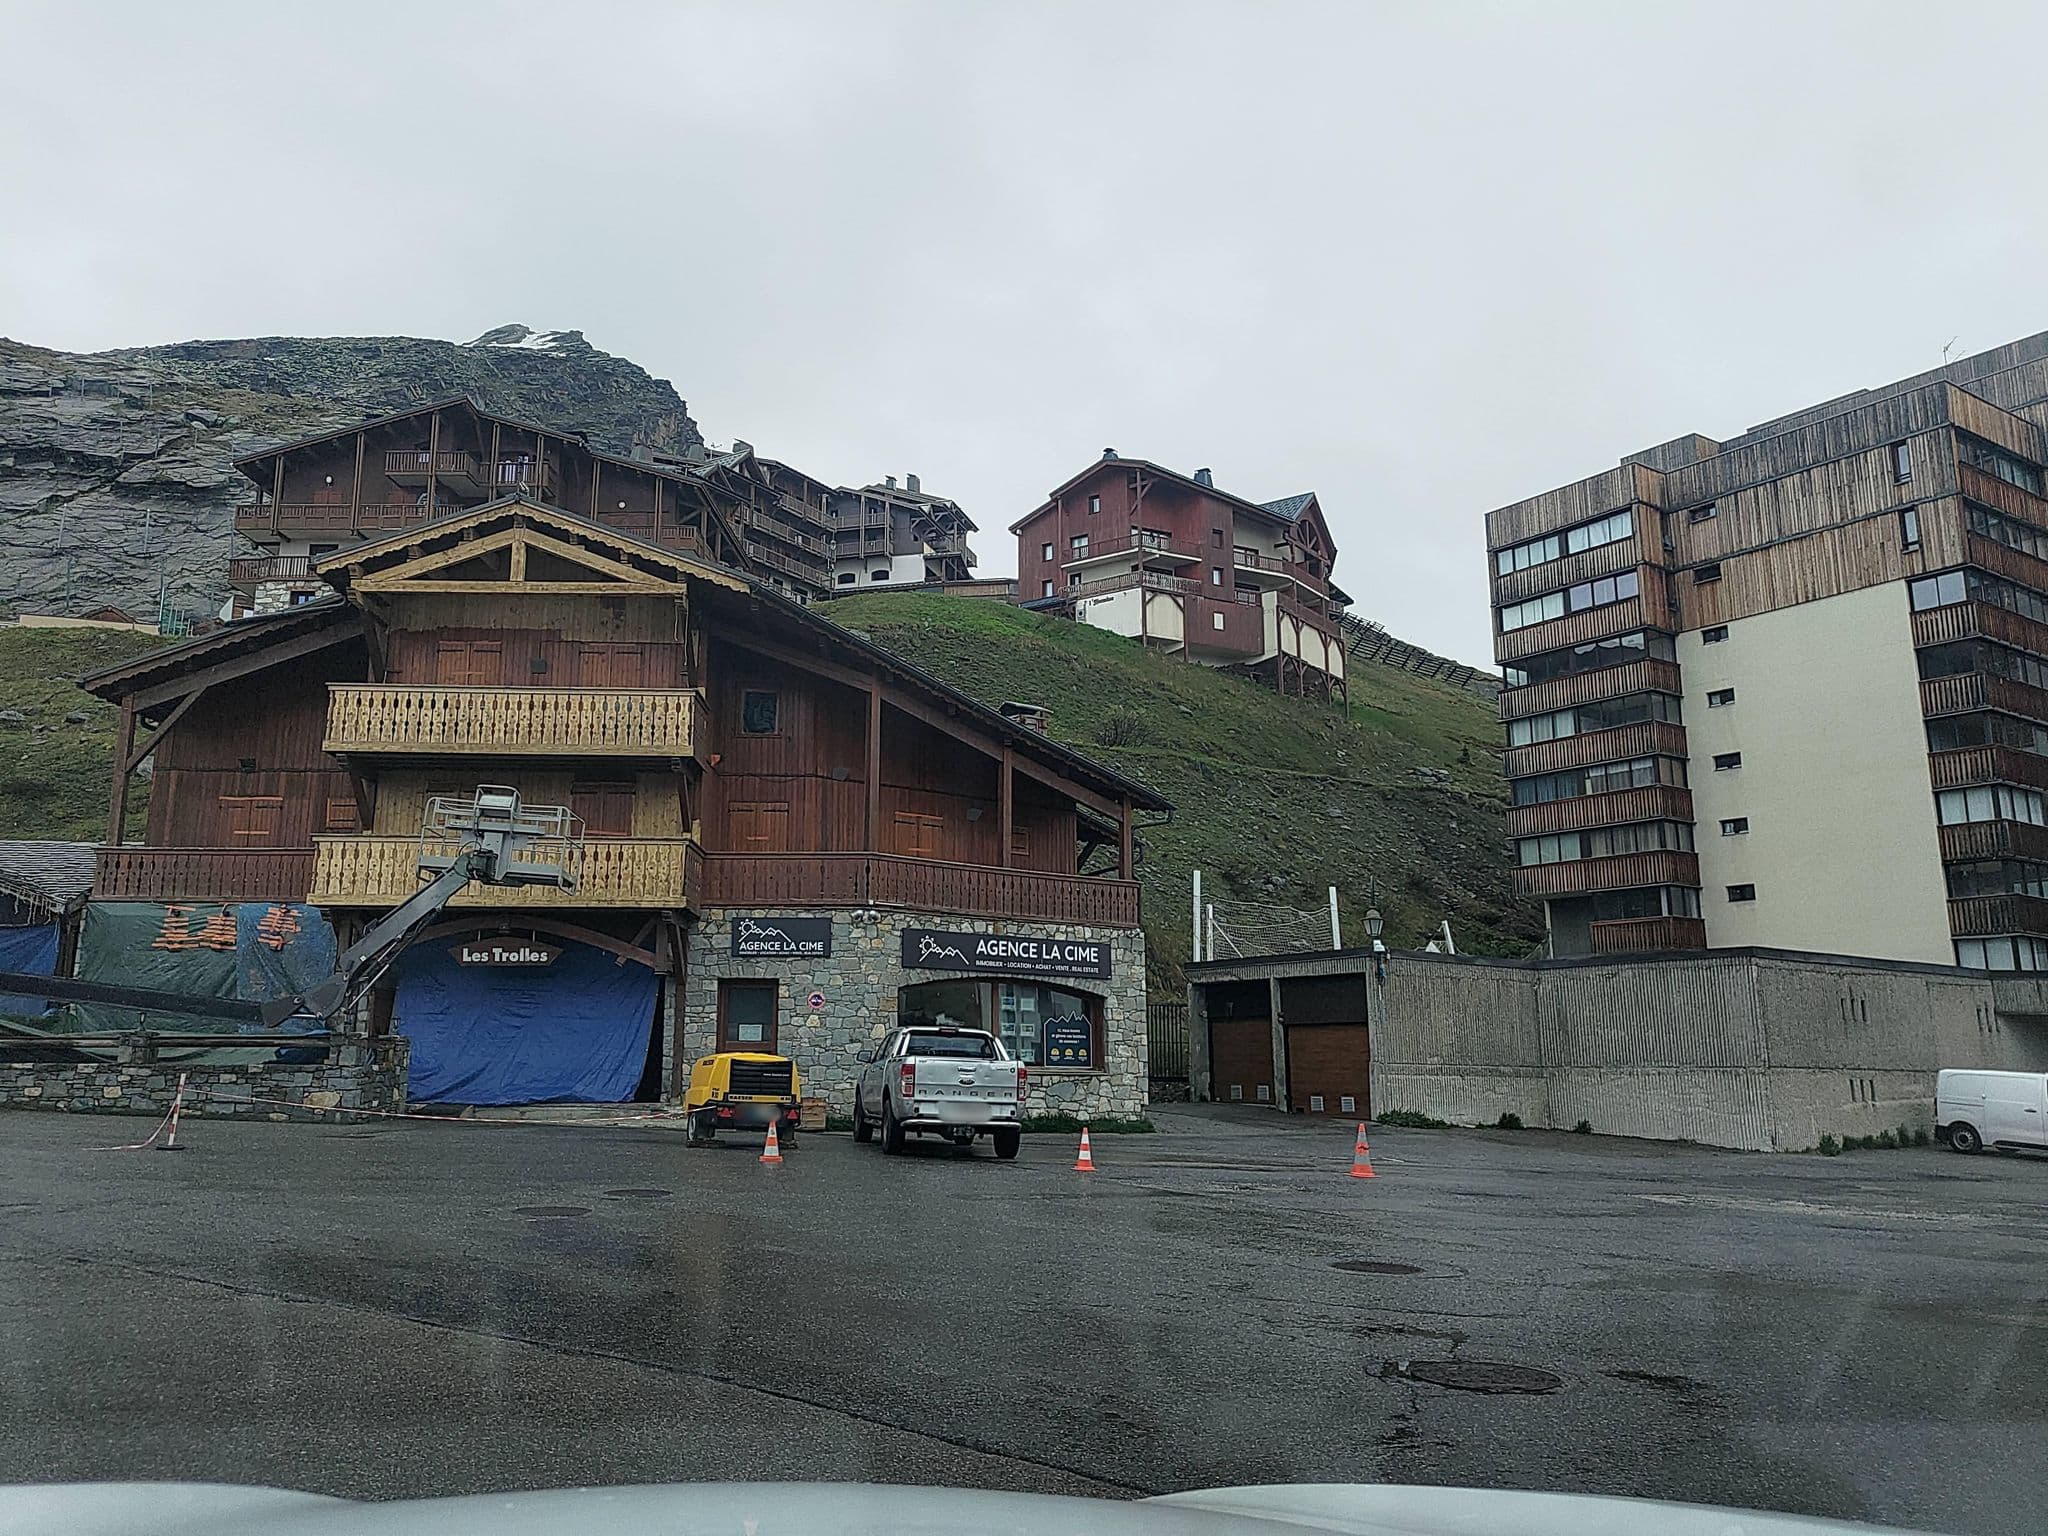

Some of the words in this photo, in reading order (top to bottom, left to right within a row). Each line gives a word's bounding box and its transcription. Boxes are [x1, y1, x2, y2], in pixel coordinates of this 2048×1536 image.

[739, 941, 781, 951] AGENCE
[783, 941, 797, 951] LA
[799, 941, 824, 951] CIME
[975, 939, 1038, 958] AGENCE
[1042, 943, 1061, 960] LA
[1064, 945, 1099, 962] CIME
[462, 947, 489, 962] Les
[492, 947, 548, 962] Trolles
[1007, 961, 1032, 969] LOCATION
[918, 1089, 1013, 1098] RANGER
